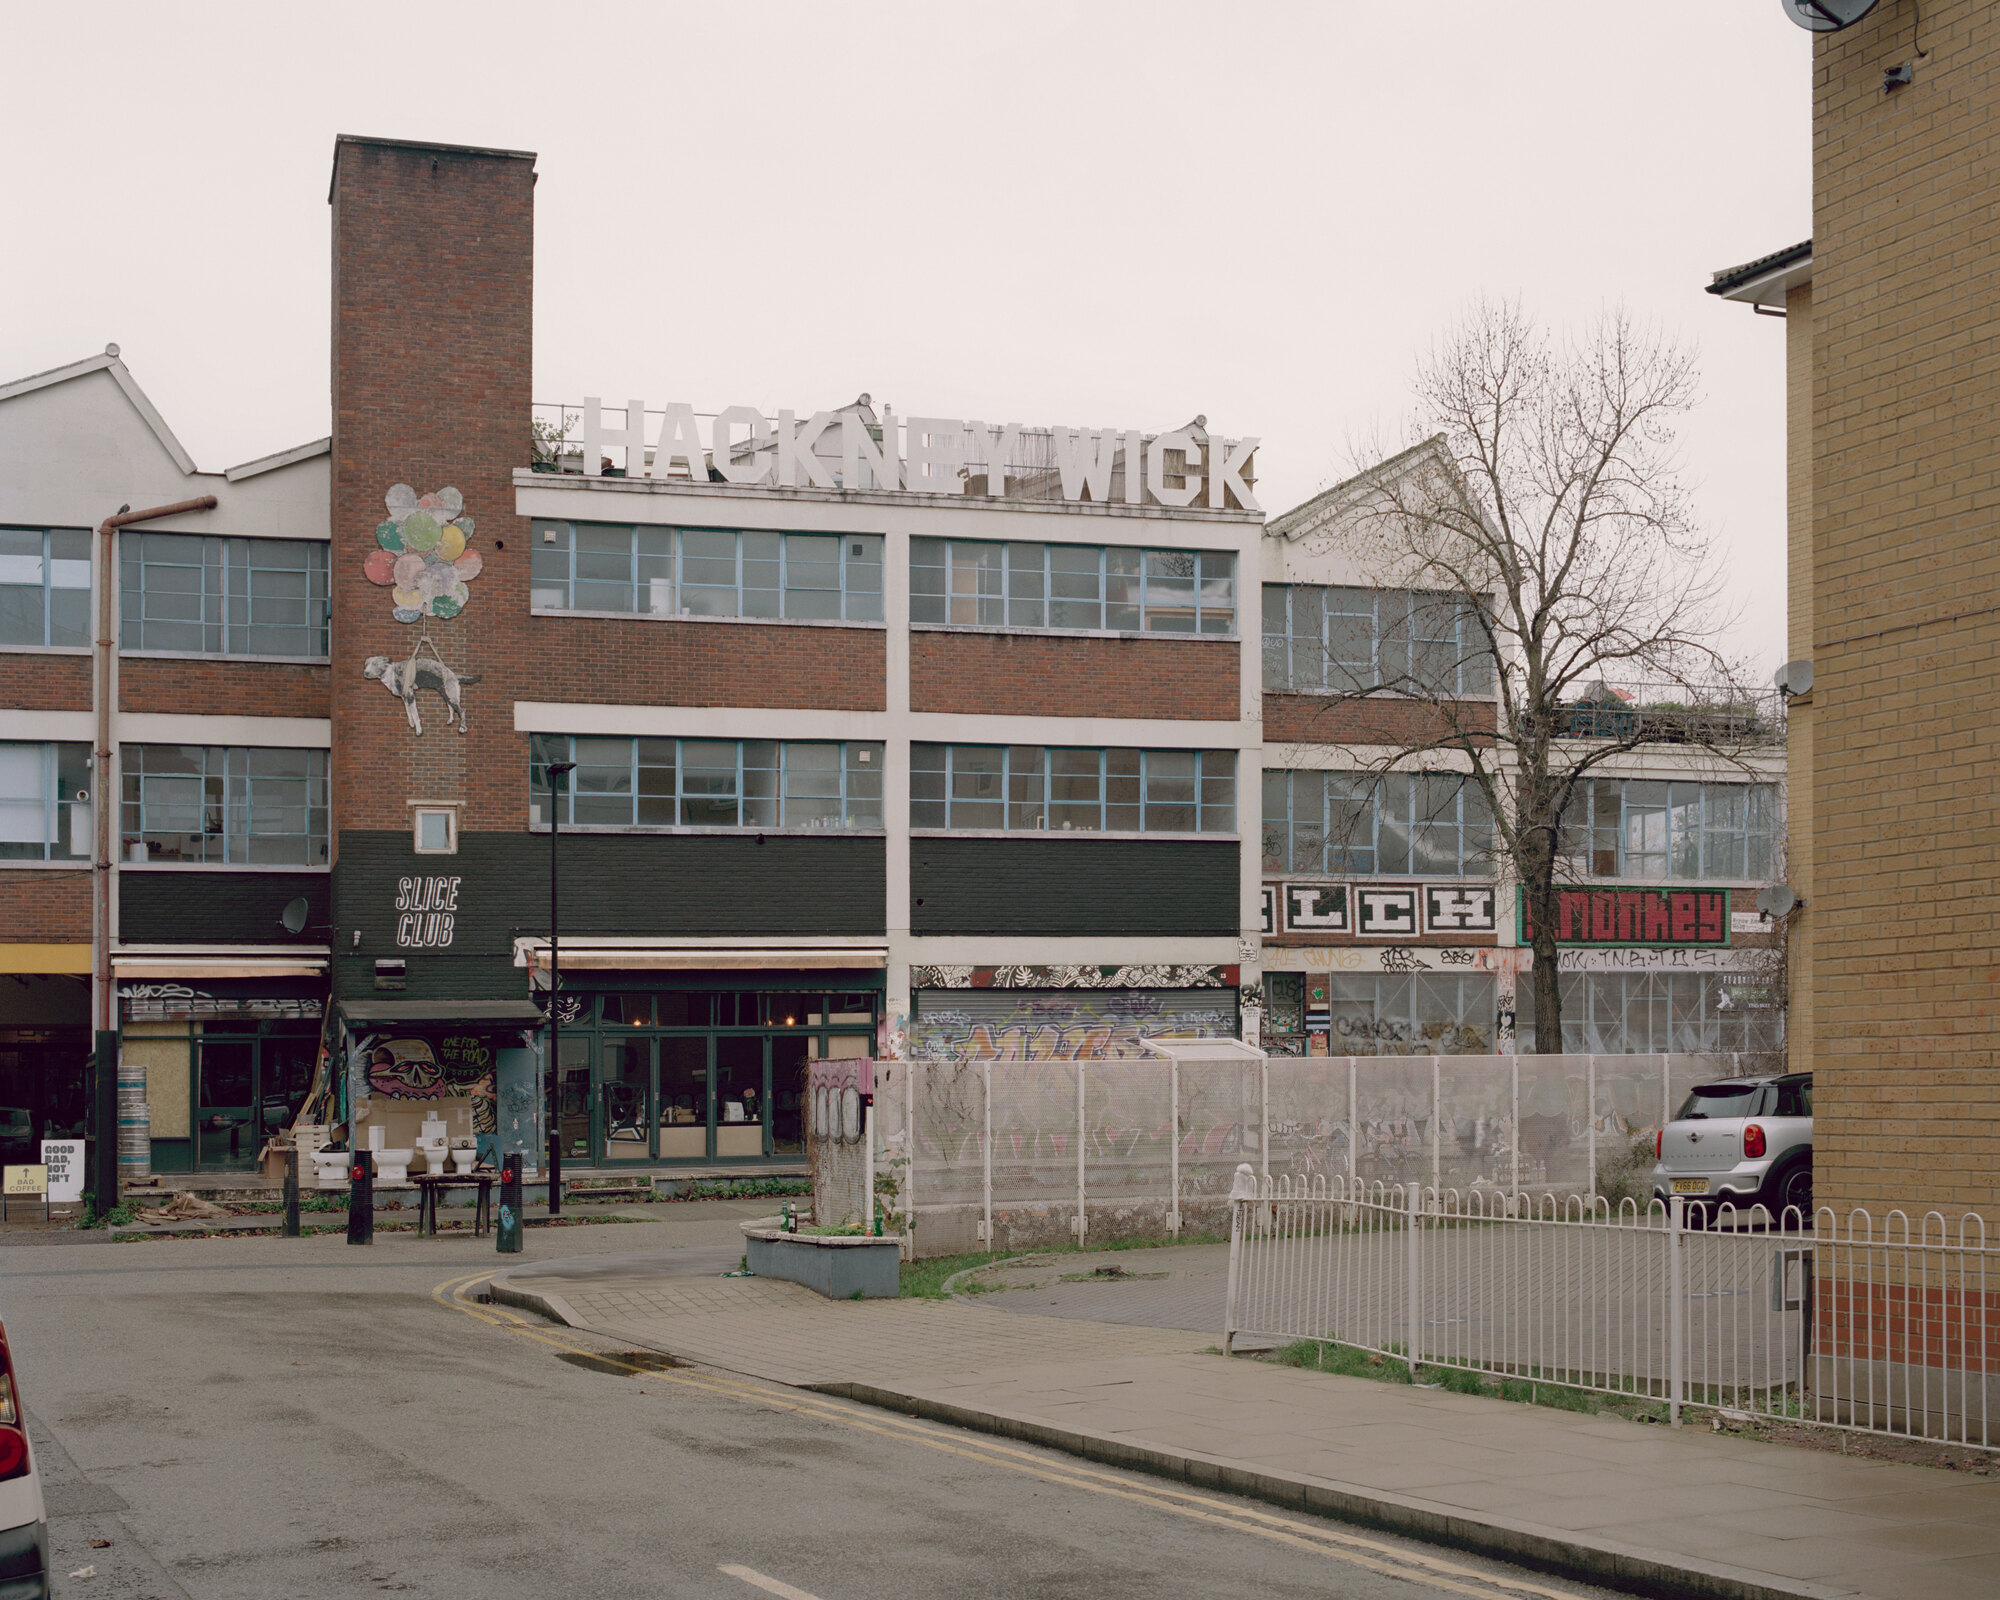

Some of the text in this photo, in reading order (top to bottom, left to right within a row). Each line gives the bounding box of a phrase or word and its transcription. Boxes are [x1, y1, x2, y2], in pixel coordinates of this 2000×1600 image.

[583, 396, 1262, 511] HACKNEY WICK
[396, 877, 461, 911] SLICE
[1262, 889, 1491, 931] LCH
[397, 913, 454, 947] CLUB
[443, 1036, 480, 1049] ONE FOR
[441, 1048, 489, 1066] THE ROAD
[45, 1145, 75, 1154] GOOD
[45, 1155, 71, 1165] BAD,
